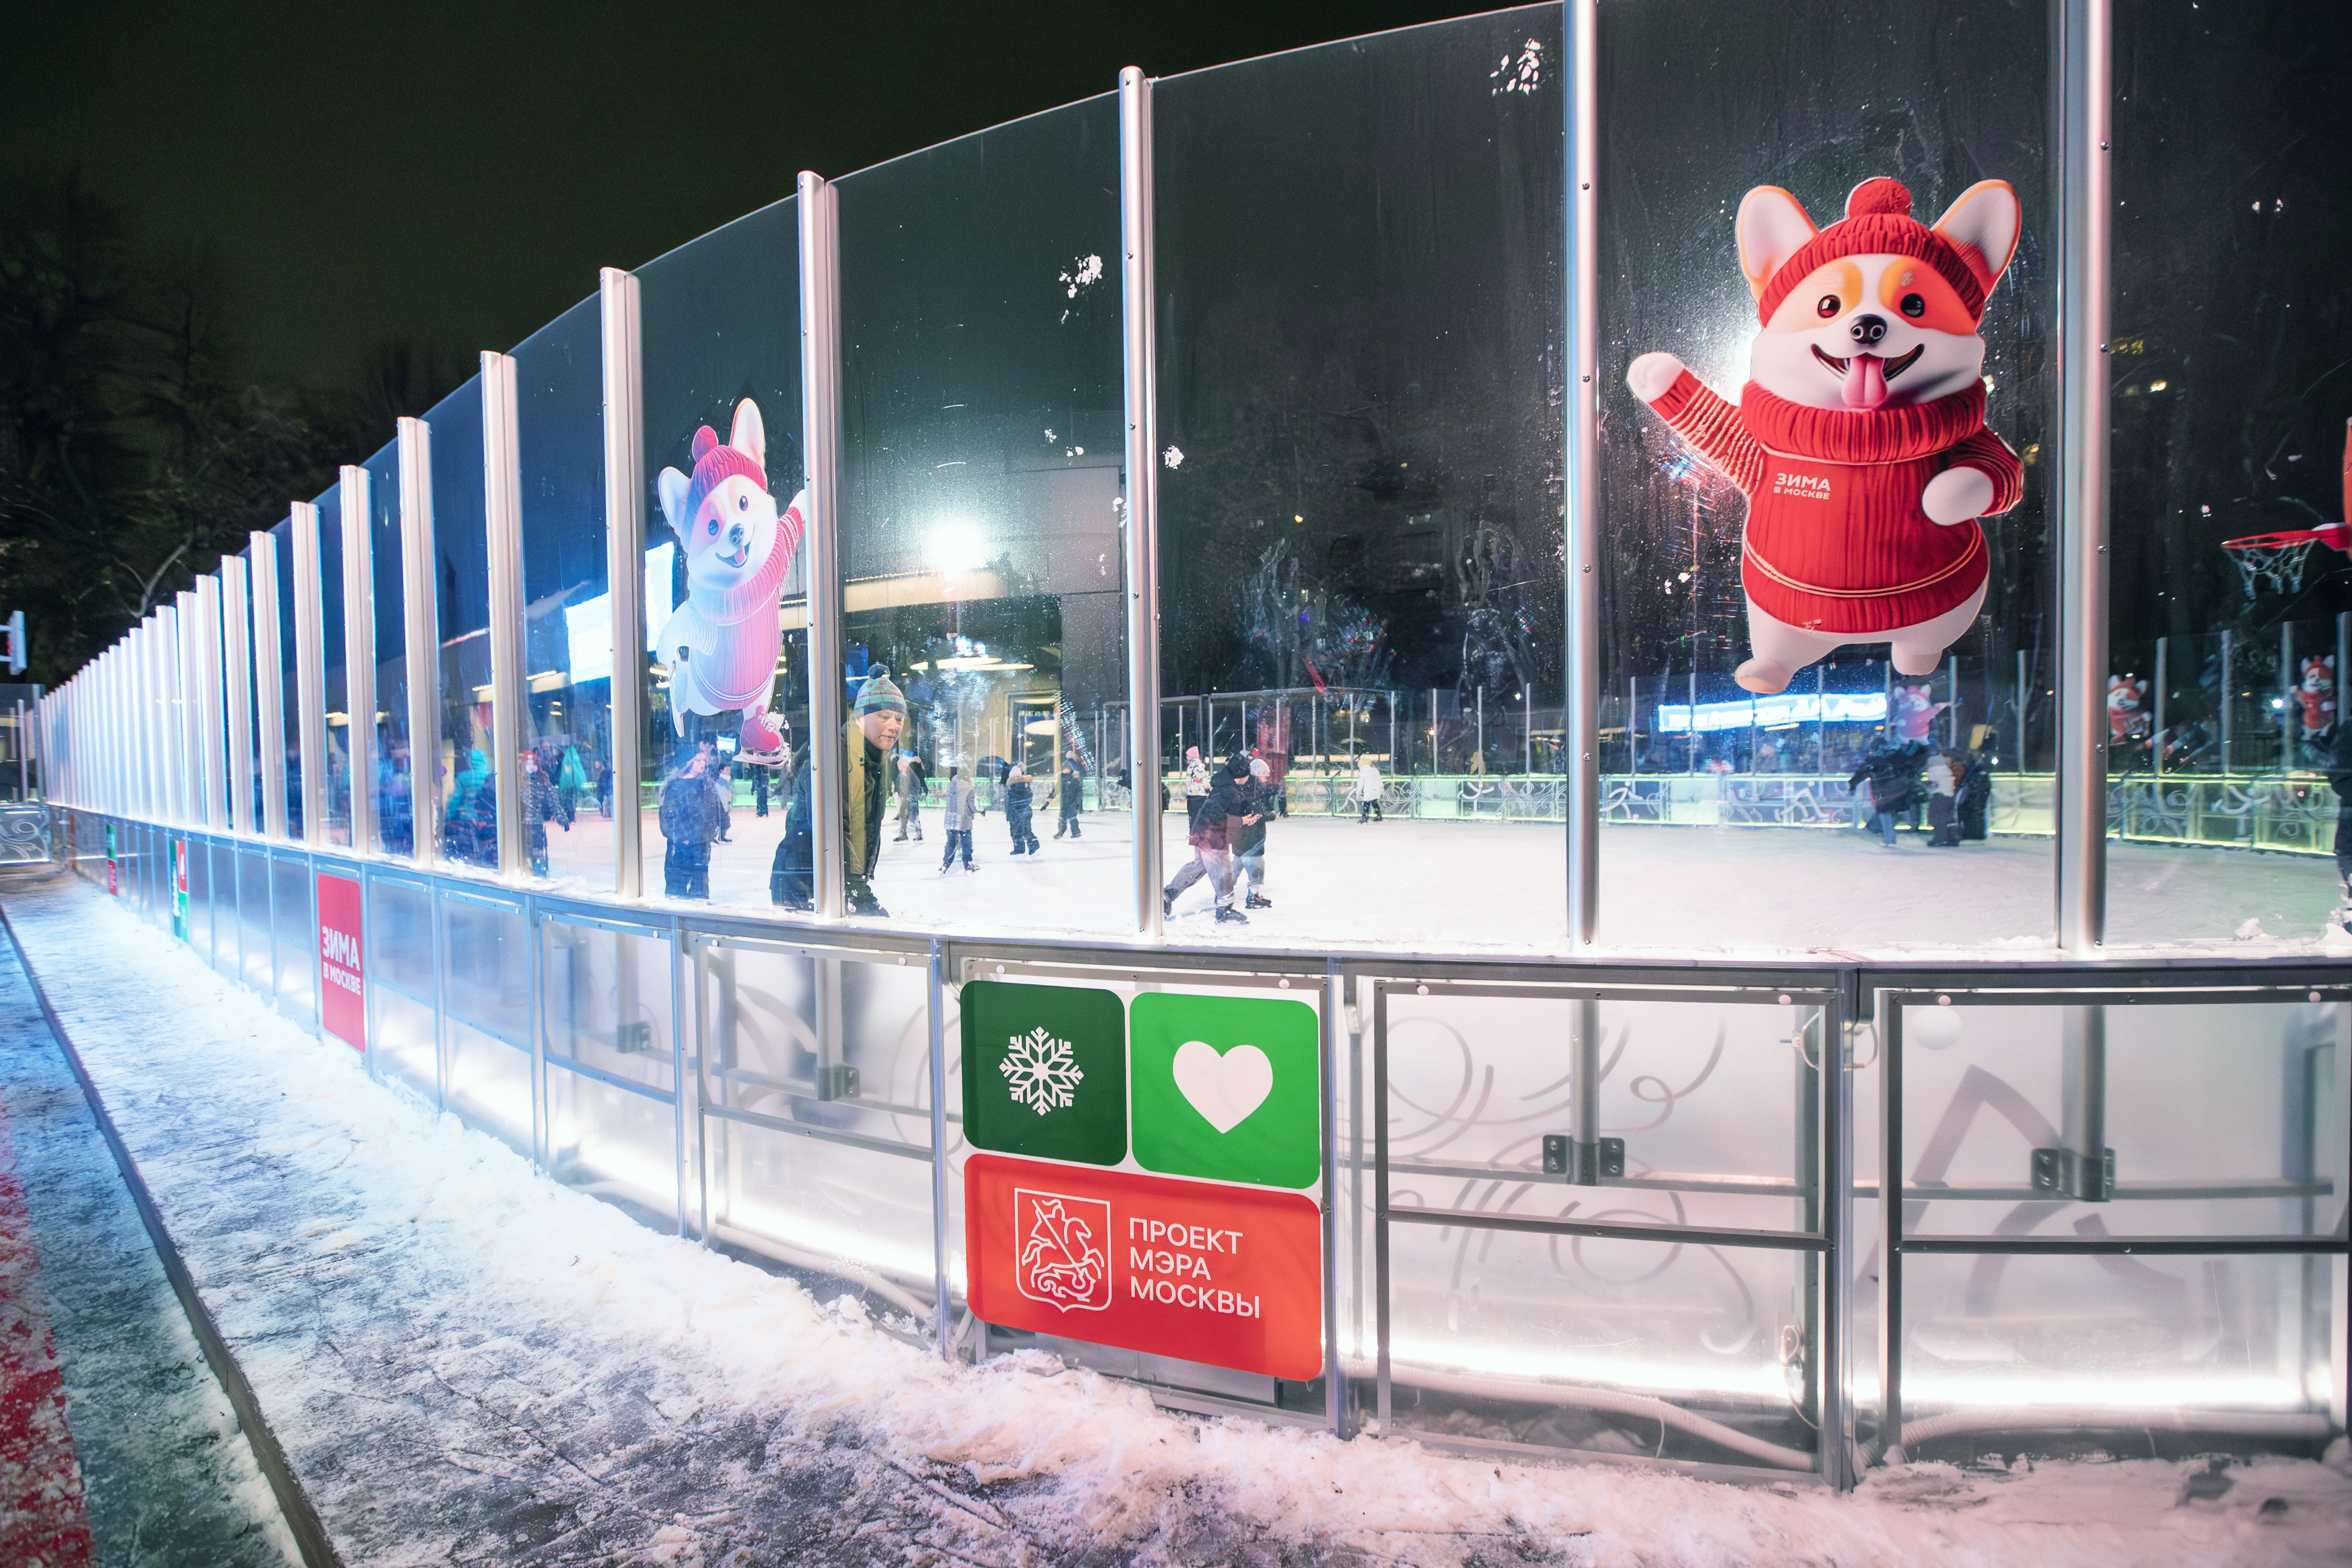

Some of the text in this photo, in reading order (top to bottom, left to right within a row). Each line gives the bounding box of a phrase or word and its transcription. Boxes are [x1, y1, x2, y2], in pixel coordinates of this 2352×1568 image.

[1775, 473, 1831, 491] ЗИМА
[1783, 487, 1830, 500] МОСКВЕ
[322, 925, 361, 971] ЗИМА
[323, 962, 361, 996] В МОСКВЕ
[1130, 1217, 1243, 1255] ПРОЕКТ
[1130, 1246, 1212, 1281] МЭРА
[1131, 1276, 1260, 1319] МОСКВЫ
